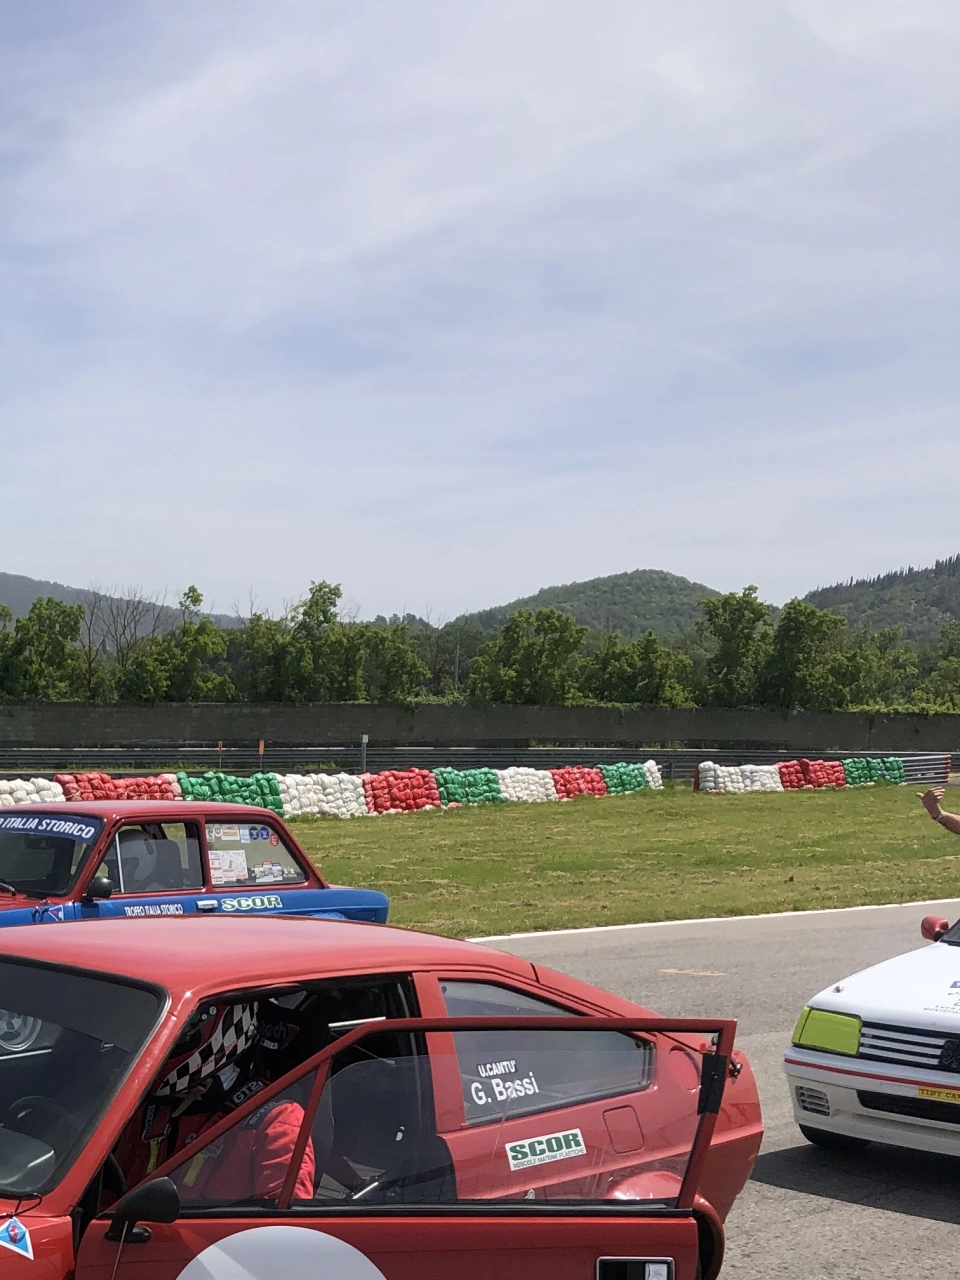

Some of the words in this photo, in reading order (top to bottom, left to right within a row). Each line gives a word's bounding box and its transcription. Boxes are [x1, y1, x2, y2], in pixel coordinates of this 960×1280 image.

[1, 817, 36, 830] ITALIA
[38, 819, 95, 839] STORICO
[221, 895, 283, 911] SCOR
[471, 1082, 492, 1105] G.
[491, 1071, 540, 1101] Bassi
[509, 1132, 582, 1161] SCOR
